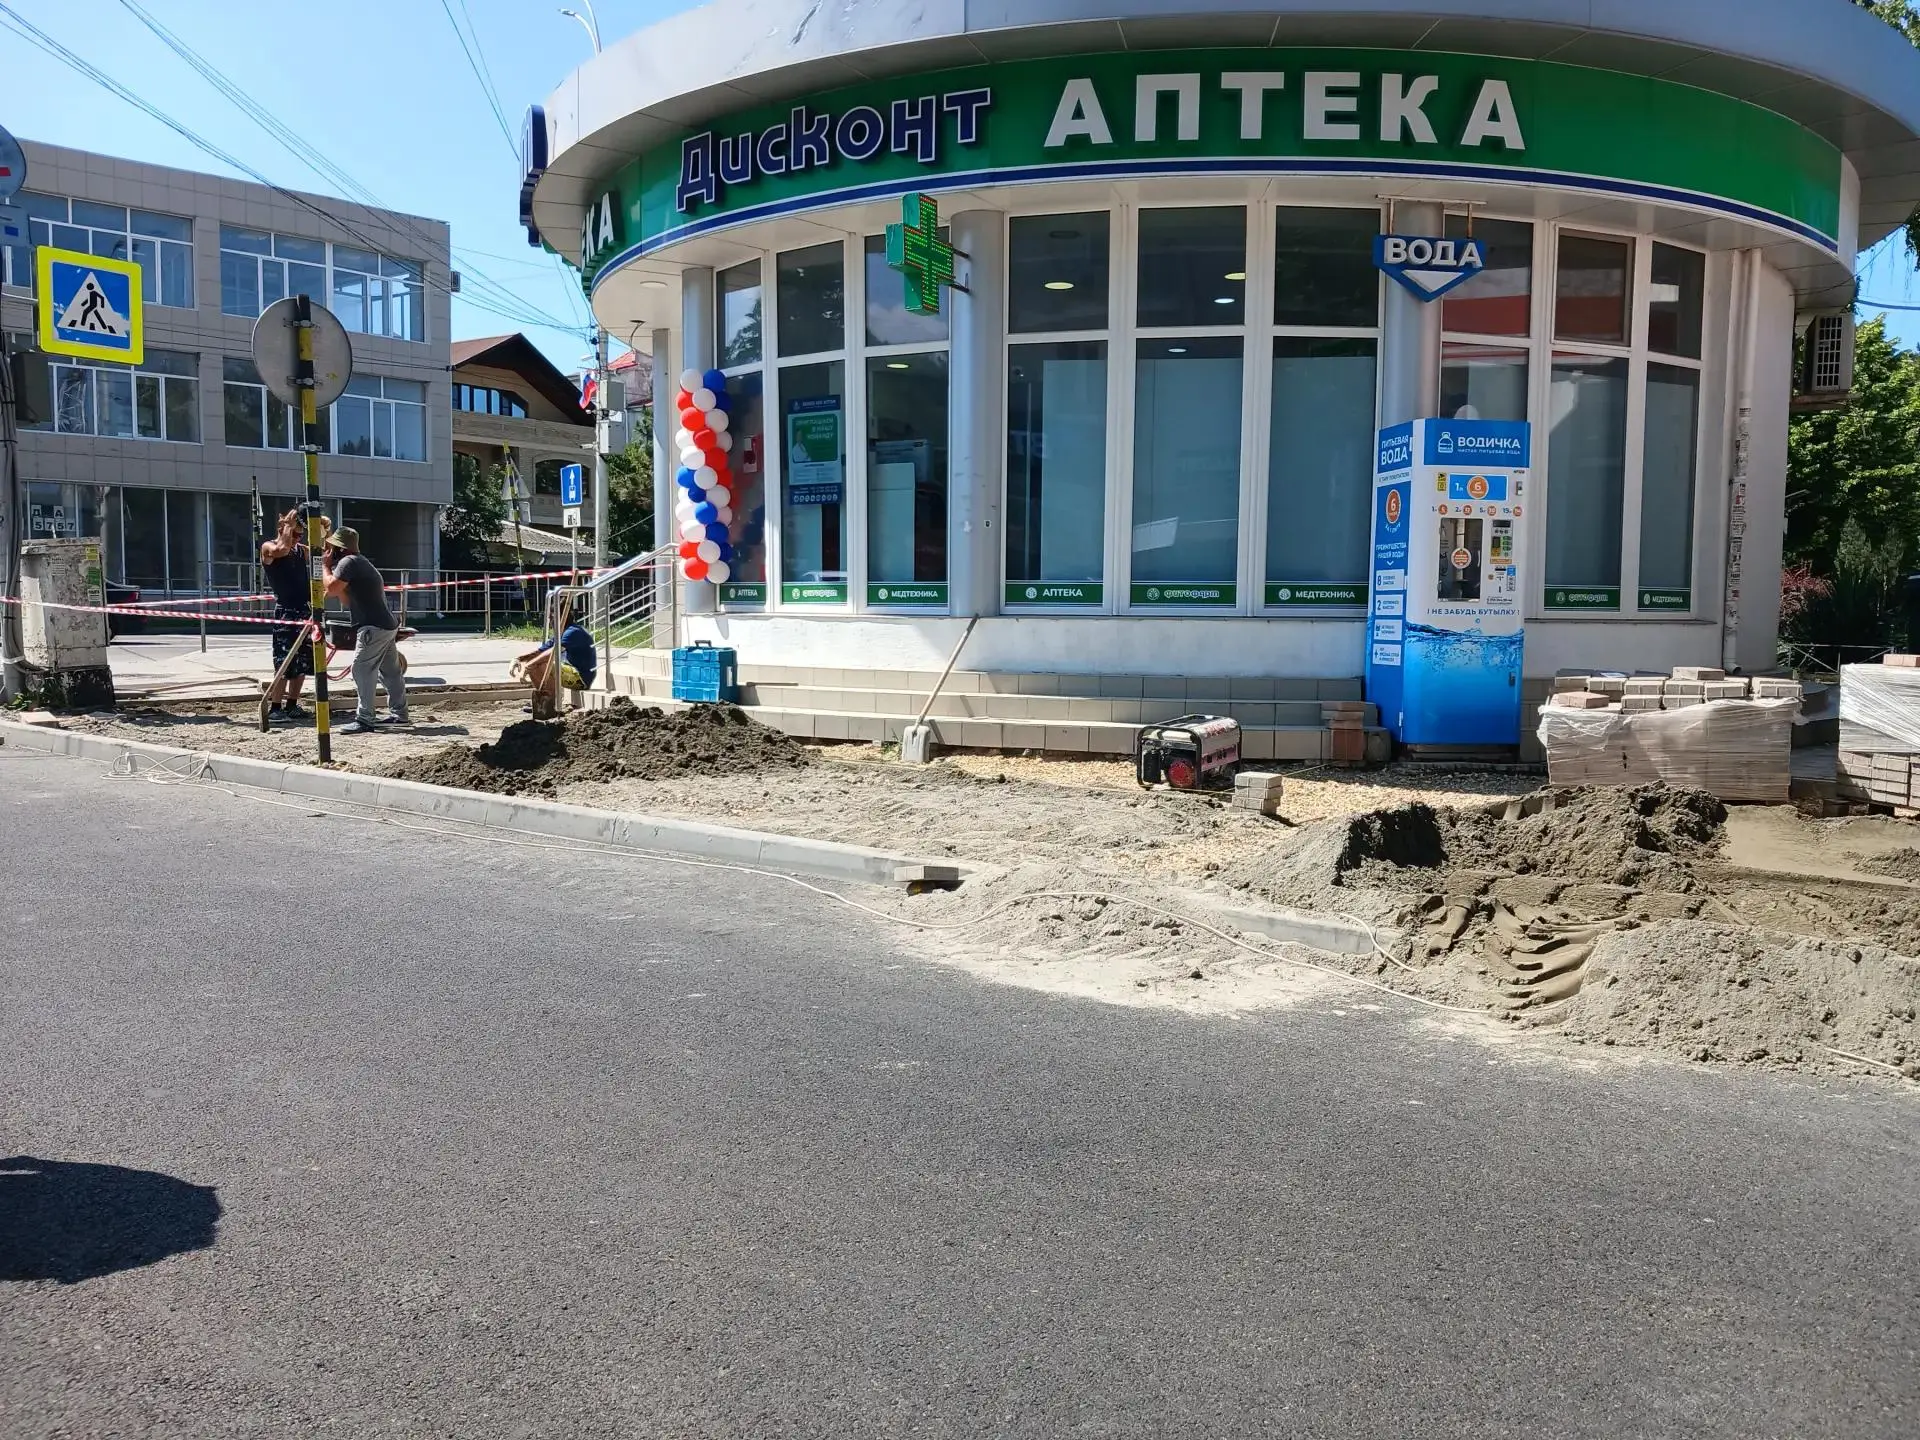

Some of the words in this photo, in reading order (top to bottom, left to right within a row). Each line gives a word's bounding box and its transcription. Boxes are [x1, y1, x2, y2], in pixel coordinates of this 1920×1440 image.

[1043, 71, 1526, 150] АПТЕКА
[676, 87, 991, 213] Дисконт
[1384, 238, 1482, 268] ВОДА
[1382, 435, 1408, 448] ПИТЬЕВАЯ
[1457, 436, 1521, 449] ВОДИЧКА
[1382, 446, 1408, 465] ВОДА
[1474, 481, 1482, 491] 6
[1390, 498, 1396, 511] 6
[35, 521, 75, 530] 5757
[1377, 575, 1382, 586] 8
[737, 589, 759, 597] АПТЕКА
[891, 589, 938, 599] МЕДТЕХНИКА
[1042, 588, 1083, 597] АПТЕКА
[1295, 590, 1355, 600] МЕДТЕХНИКА
[1377, 599, 1382, 611] 2
[1651, 595, 1684, 604] МЕДТЕХНИКА
[1444, 608, 1477, 616] ЗАБУДЬ
[1478, 608, 1516, 616] БУТЫЛКУ
